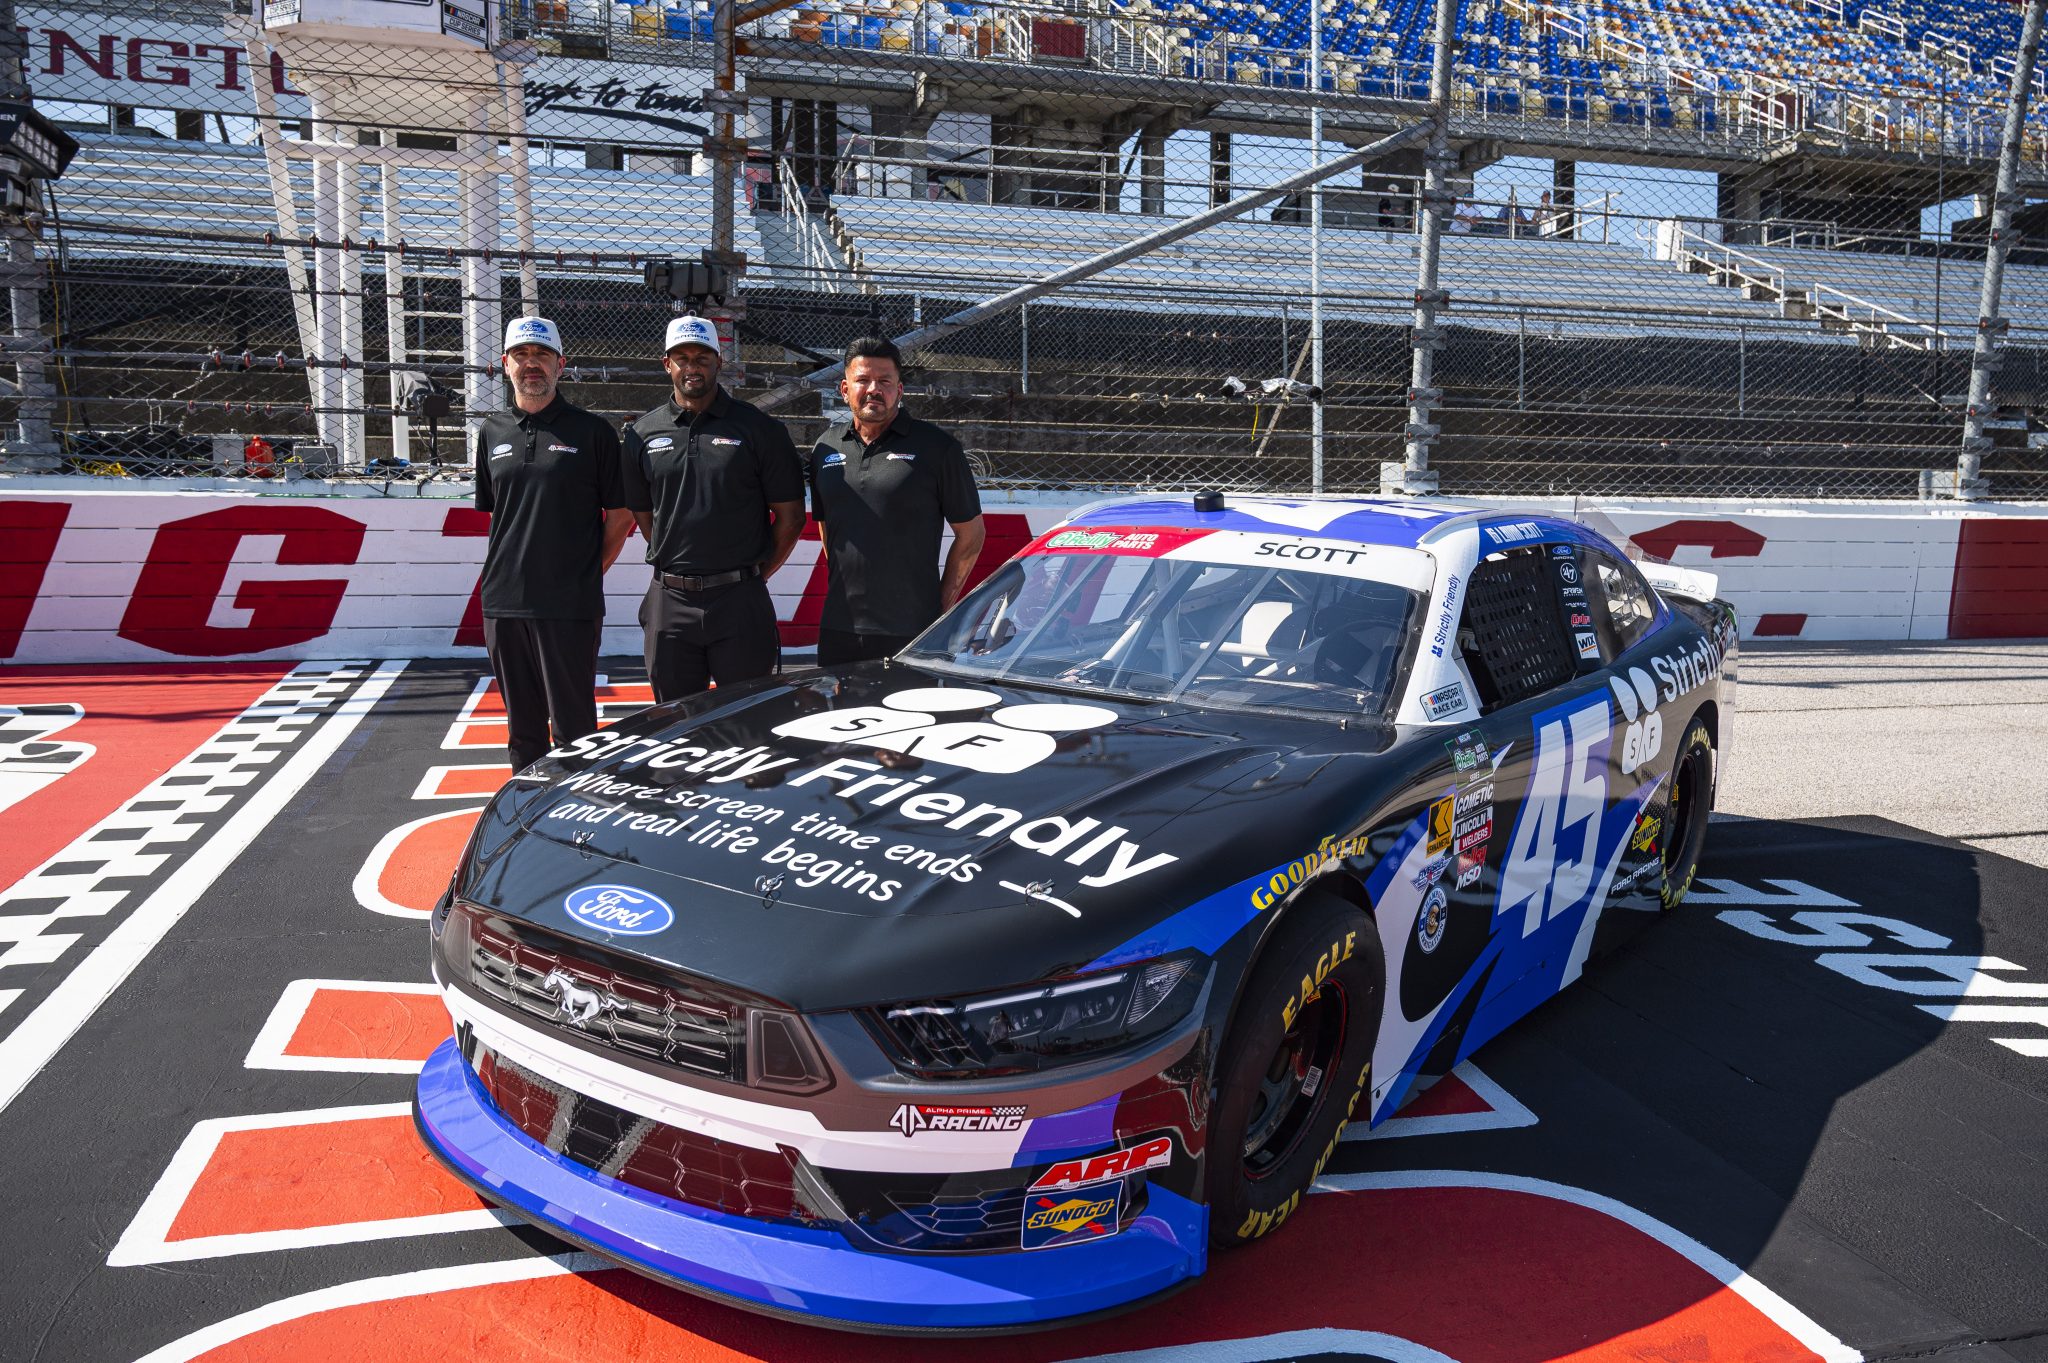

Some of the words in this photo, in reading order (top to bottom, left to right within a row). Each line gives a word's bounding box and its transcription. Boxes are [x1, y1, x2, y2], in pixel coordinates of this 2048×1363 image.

[458, 9, 481, 25] NASCAR
[461, 22, 481, 36] SERIES
[587, 77, 630, 108] to
[1111, 541, 1155, 549] PARTS
[1124, 533, 1159, 541] AUTO
[1254, 542, 1367, 564] SCOTT
[1443, 574, 1461, 616] Friendly
[1435, 612, 1454, 645] Strictly
[1578, 635, 1596, 649] WIX
[1432, 703, 1450, 716] RACE
[1450, 698, 1463, 710] CAR
[1435, 687, 1459, 705] NASCAR
[546, 731, 800, 784] Strictly
[786, 757, 1180, 888] Friendly
[1456, 782, 1494, 815] COMETIC
[557, 770, 664, 799] Where
[664, 790, 785, 824] screen
[790, 812, 882, 851] time
[884, 844, 983, 882] ends
[1456, 812, 1486, 838] LINCOLN
[1498, 700, 1610, 939] 45
[1462, 827, 1488, 848] WELDERS
[548, 802, 627, 824] and
[612, 812, 699, 837] real
[687, 819, 759, 854] life
[762, 837, 902, 902] begins
[1251, 835, 1369, 910] GOODYEAR
[1456, 865, 1481, 891] MSD
[1610, 874, 1632, 895] FORD
[1632, 857, 1660, 880] RACING
[579, 889, 656, 929] Ford
[1282, 931, 1356, 1034] EAGLE
[928, 1115, 1023, 1130] RACING
[1032, 1138, 1171, 1187] ARP
[1028, 1201, 1112, 1227] SUNOCO
